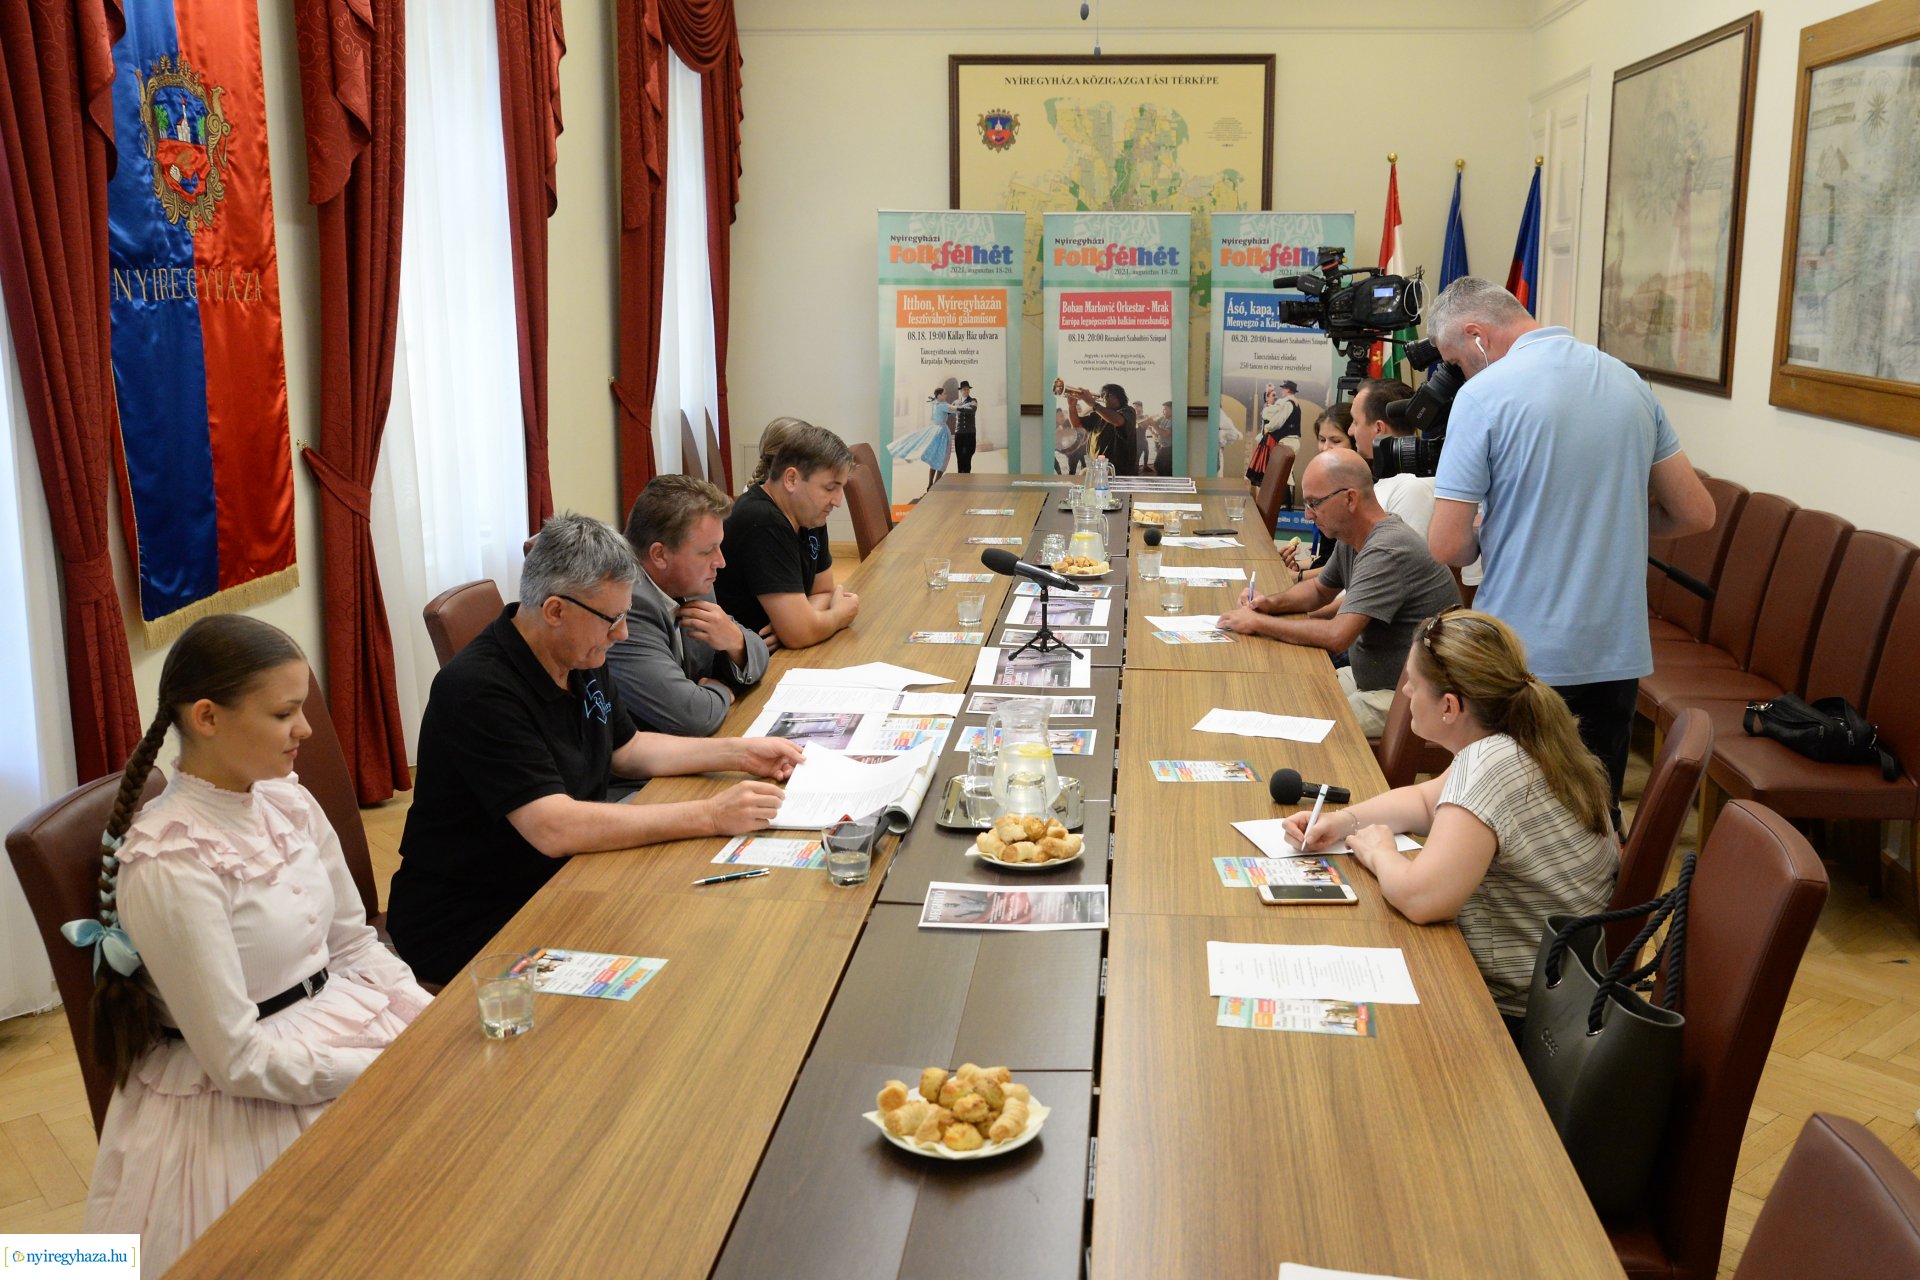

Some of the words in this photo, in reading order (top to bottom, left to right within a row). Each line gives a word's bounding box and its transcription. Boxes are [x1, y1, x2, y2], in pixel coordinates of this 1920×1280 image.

[1005, 74, 1080, 85] NYÍREGYHÁZA
[1082, 74, 1169, 85] KÖZIGAZGATÁSI
[1171, 74, 1219, 85] TÉRKÉPE
[903, 294, 935, 312] Itthon,
[938, 294, 1002, 312] Nyíregyházán
[1062, 301, 1083, 313] Boban
[1116, 301, 1145, 313] Orkestar
[1151, 300, 1169, 313] Mrak
[1227, 298, 1248, 316] Ásó,
[1250, 301, 1275, 316] kapa,
[1226, 316, 1259, 329] Menyegző
[1260, 320, 1265, 328] a
[929, 331, 947, 340] 19:00
[966, 330, 978, 340] Ház
[979, 330, 999, 340] udvara
